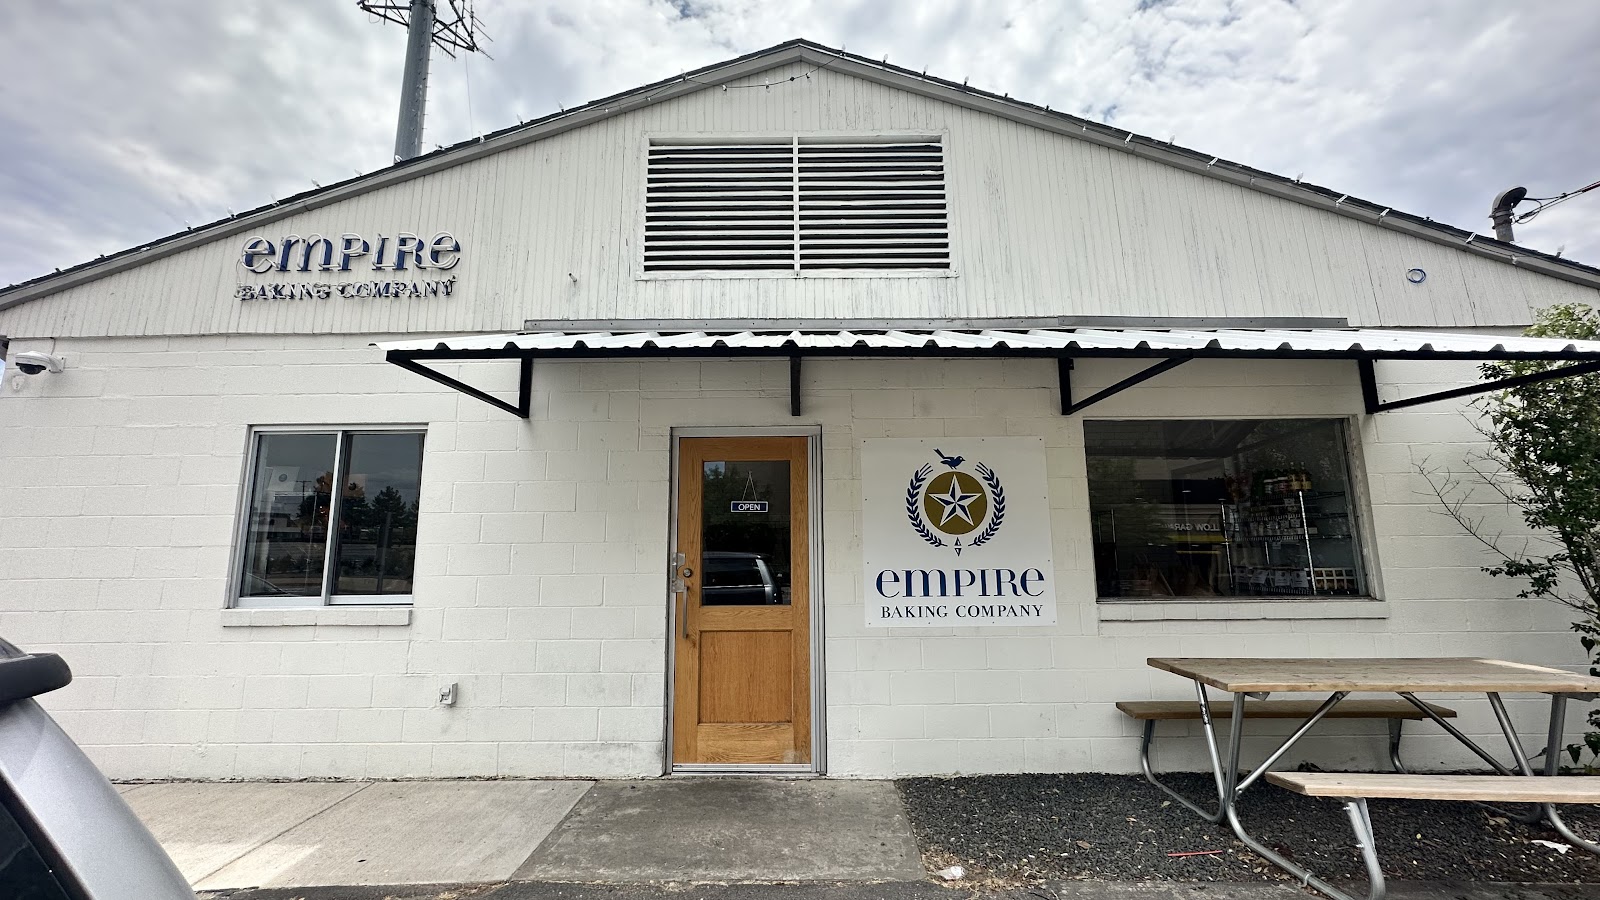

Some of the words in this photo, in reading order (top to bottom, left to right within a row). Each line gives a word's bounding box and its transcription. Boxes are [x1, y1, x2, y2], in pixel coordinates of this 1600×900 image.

[235, 282, 331, 301] BAKING
[336, 275, 457, 299] COMPANY
[880, 605, 948, 619] BAKING
[955, 604, 1044, 618] COMPANY
